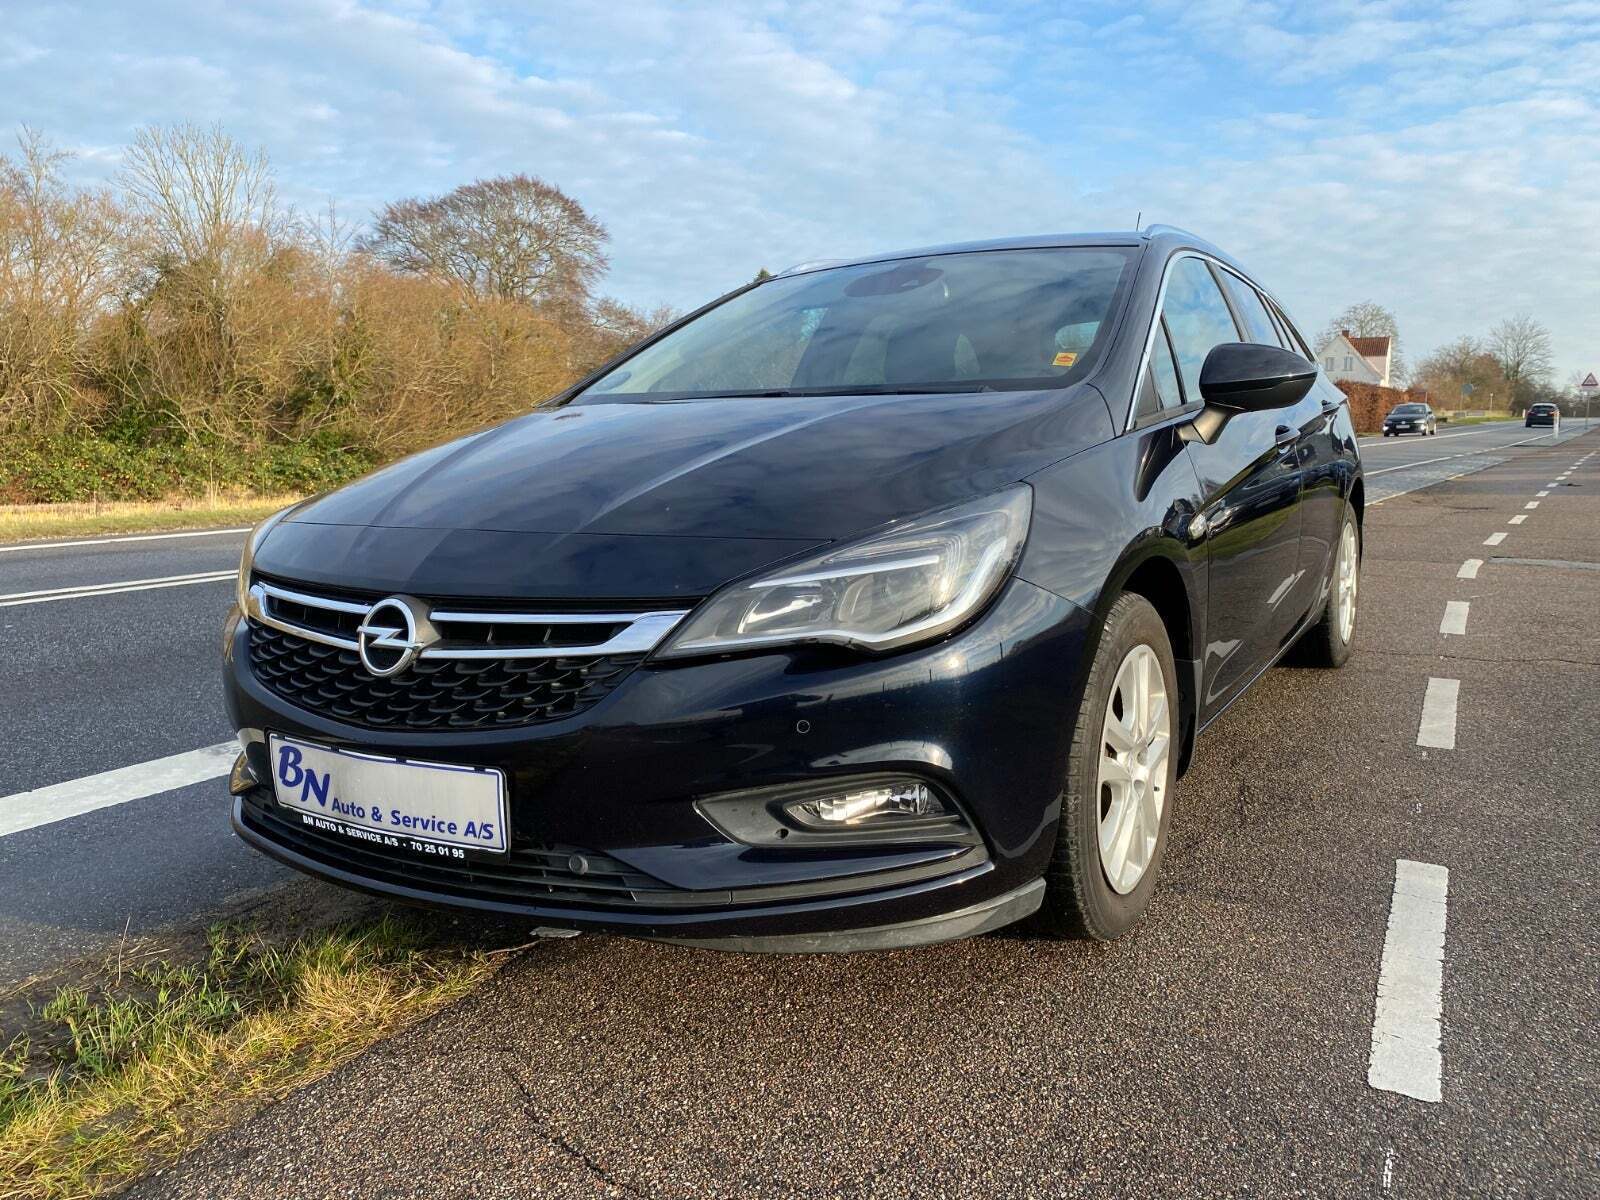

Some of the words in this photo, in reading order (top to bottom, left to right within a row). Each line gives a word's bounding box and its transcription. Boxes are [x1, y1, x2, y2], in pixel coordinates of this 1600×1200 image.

[278, 746, 330, 807] BN
[303, 815, 314, 825] BN
[315, 820, 337, 832] AUTO
[346, 827, 382, 842] SERVICE
[384, 837, 398, 847] A/S
[411, 841, 422, 851] 70
[425, 844, 436, 853] 25
[439, 846, 449, 856] 01
[452, 849, 464, 858] 95
[332, 798, 365, 818] Auto
[371, 807, 382, 822] &
[391, 810, 457, 834] Service
[464, 821, 494, 840] A/S
